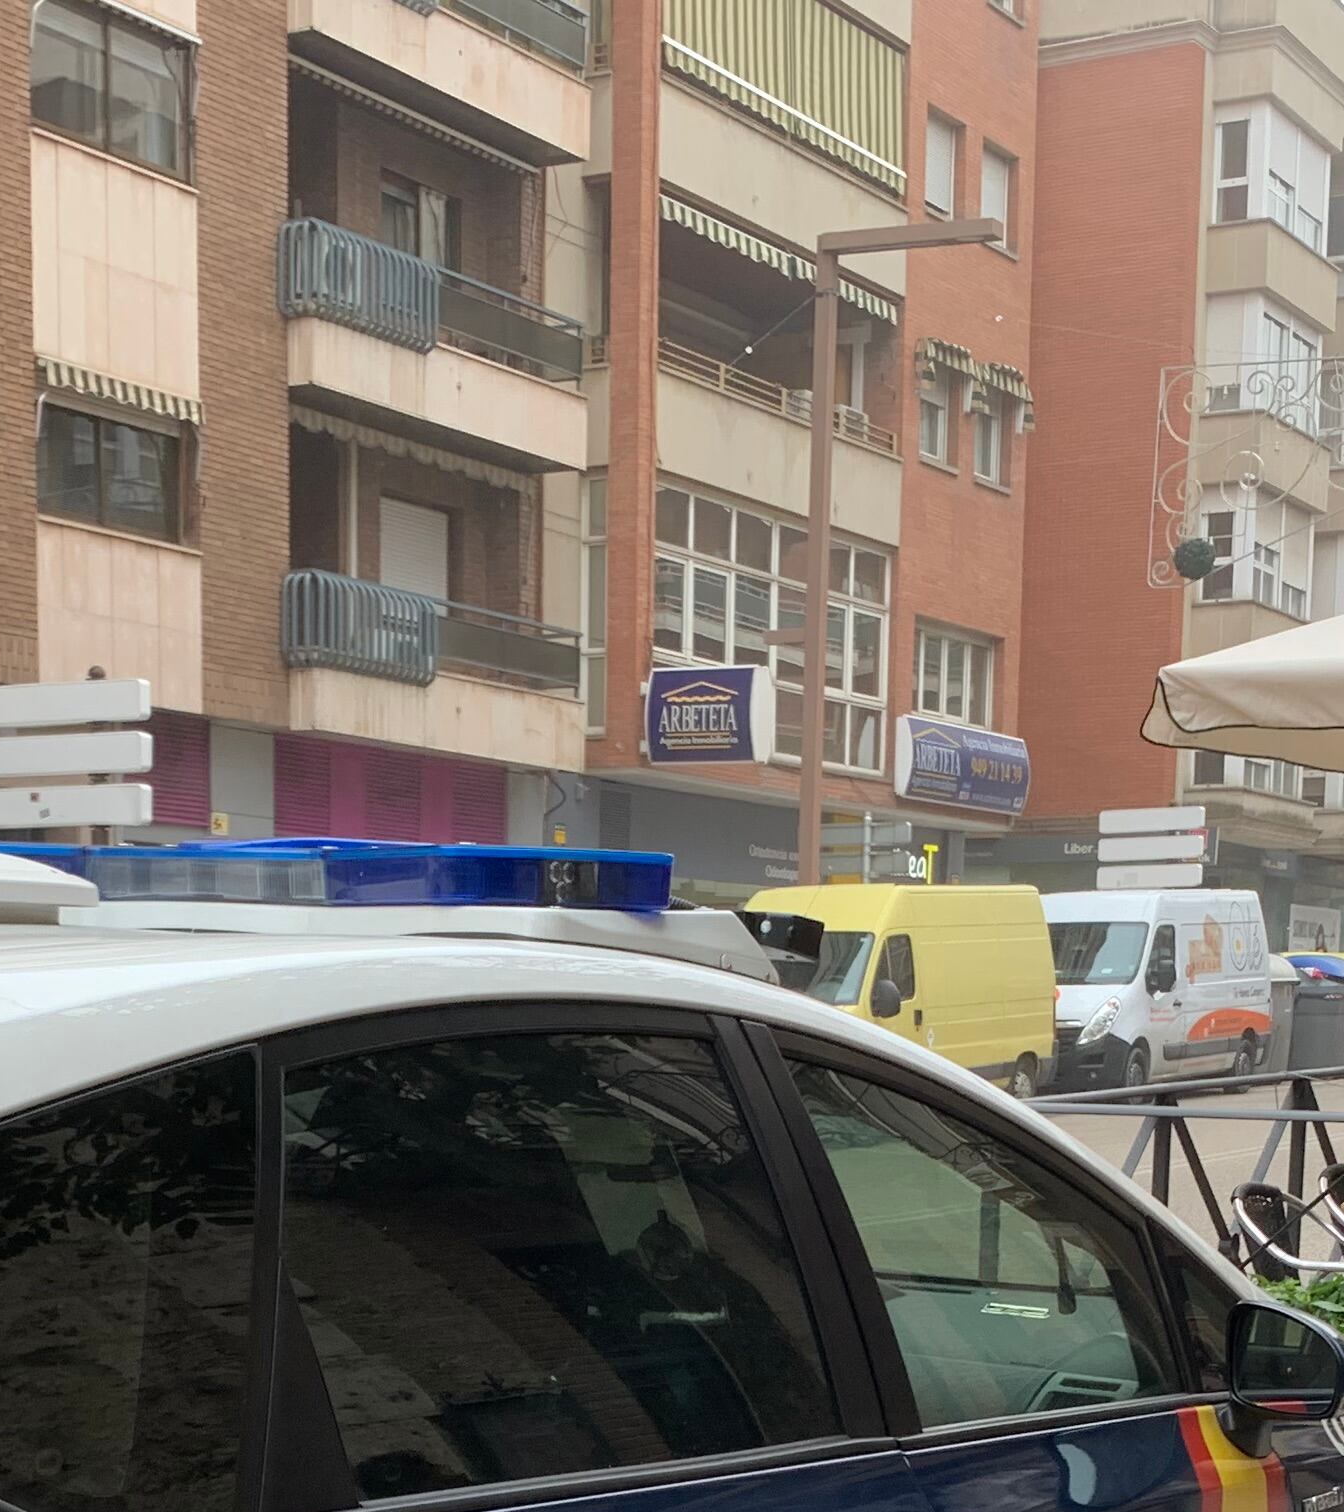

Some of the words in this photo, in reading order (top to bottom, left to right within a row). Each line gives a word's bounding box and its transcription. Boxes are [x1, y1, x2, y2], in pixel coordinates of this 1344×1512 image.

[659, 704, 738, 732] ARBETETA
[915, 743, 961, 777] ARBETETA
[971, 756, 988, 777] 949
[1064, 842, 1094, 855] Liber
